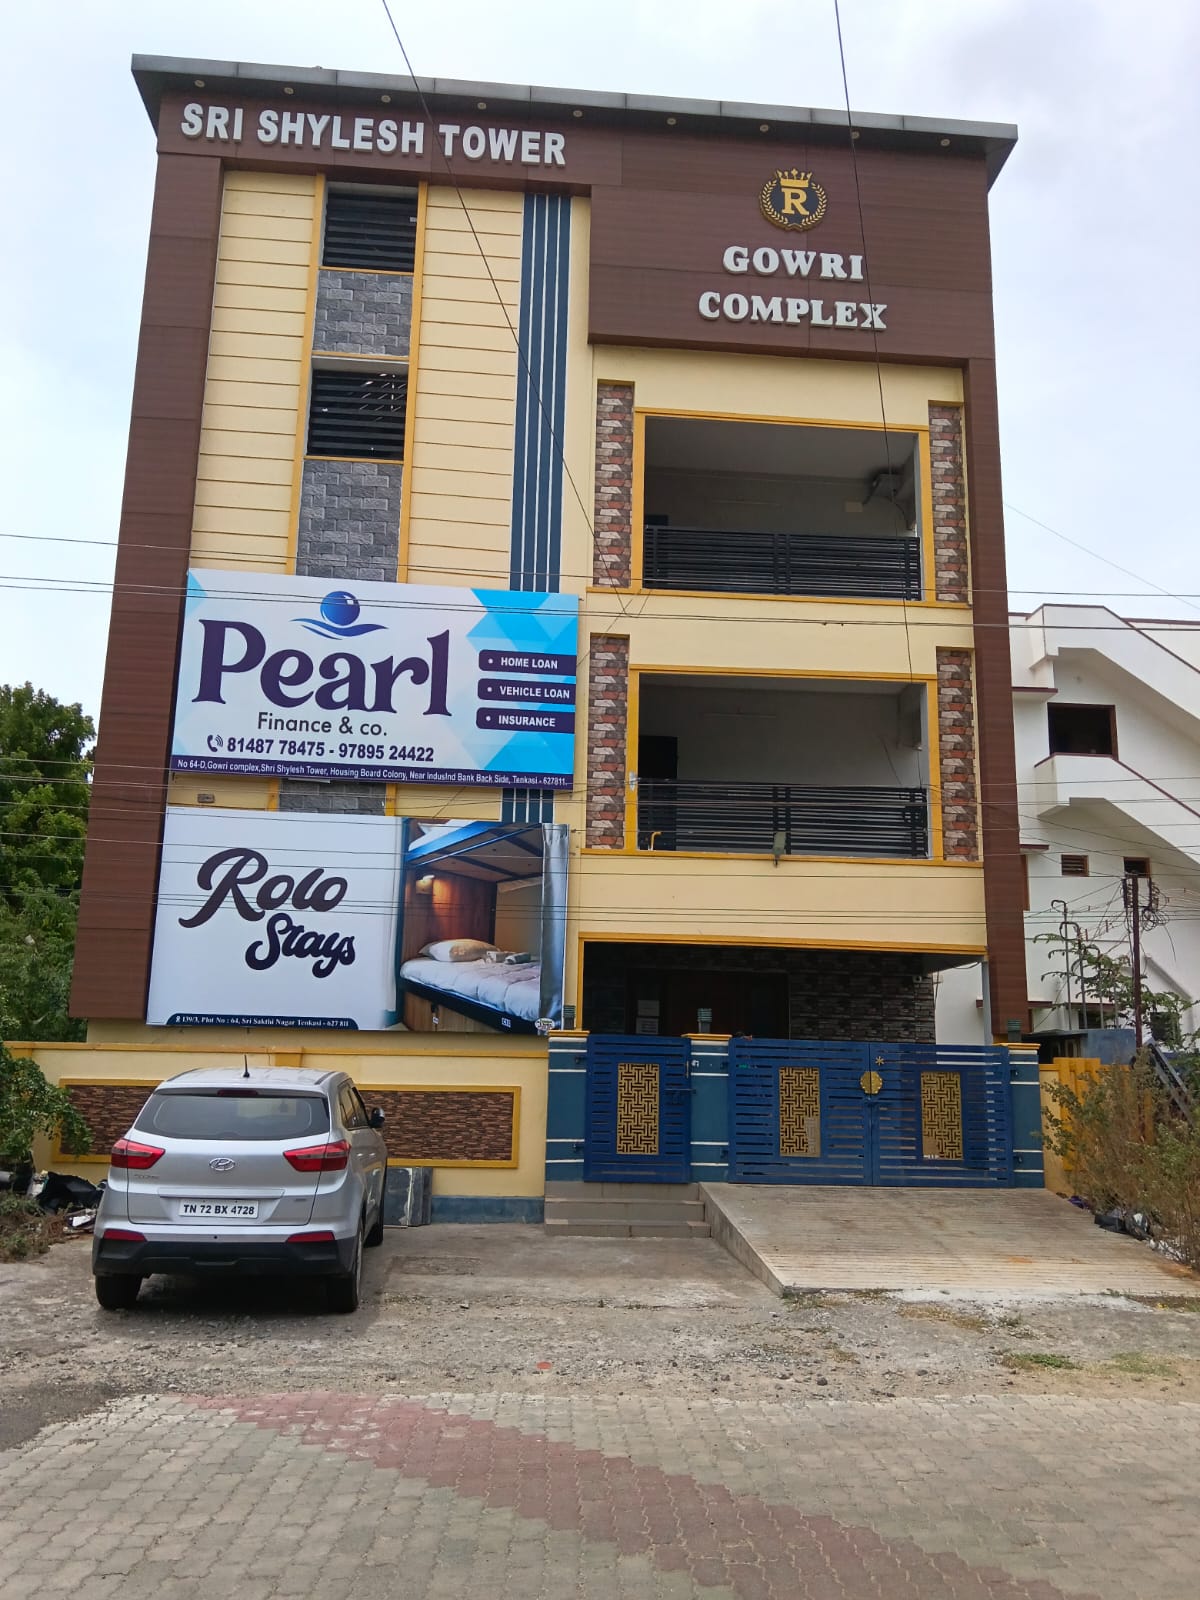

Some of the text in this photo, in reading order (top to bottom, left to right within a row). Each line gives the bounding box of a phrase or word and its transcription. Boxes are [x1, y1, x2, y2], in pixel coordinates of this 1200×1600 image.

[181, 102, 567, 166] SRI SHYLESH TOWER
[781, 188, 810, 216] R
[722, 245, 864, 282] GOWRI
[698, 291, 888, 331] COMPLEX
[191, 618, 453, 717] Pearl
[501, 657, 558, 669] HOME LOAN
[499, 685, 570, 699] VEHICLE LOAN
[257, 711, 387, 736] Finance & co.
[498, 715, 556, 727] INSURANCE
[227, 737, 274, 754] 81487
[279, 740, 325, 756] 78475
[339, 743, 385, 759] 97895
[389, 745, 434, 762] 24422
[178, 759, 188, 768] No
[277, 764, 305, 775] Shylesh
[306, 765, 329, 776] Tower,
[330, 766, 359, 778] Housing
[360, 767, 381, 778] Board
[382, 769, 408, 781] Colony,
[410, 771, 426, 780] Near
[457, 773, 475, 783] Bank
[476, 773, 493, 783] Back
[494, 775, 511, 785] Side,
[512, 775, 538, 785] Tenkasi
[178, 847, 348, 929] Rolo
[245, 912, 356, 979] Stays
[275, 1018, 295, 1026] Nagar
[184, 1204, 255, 1215] TN 72 BX 4728
